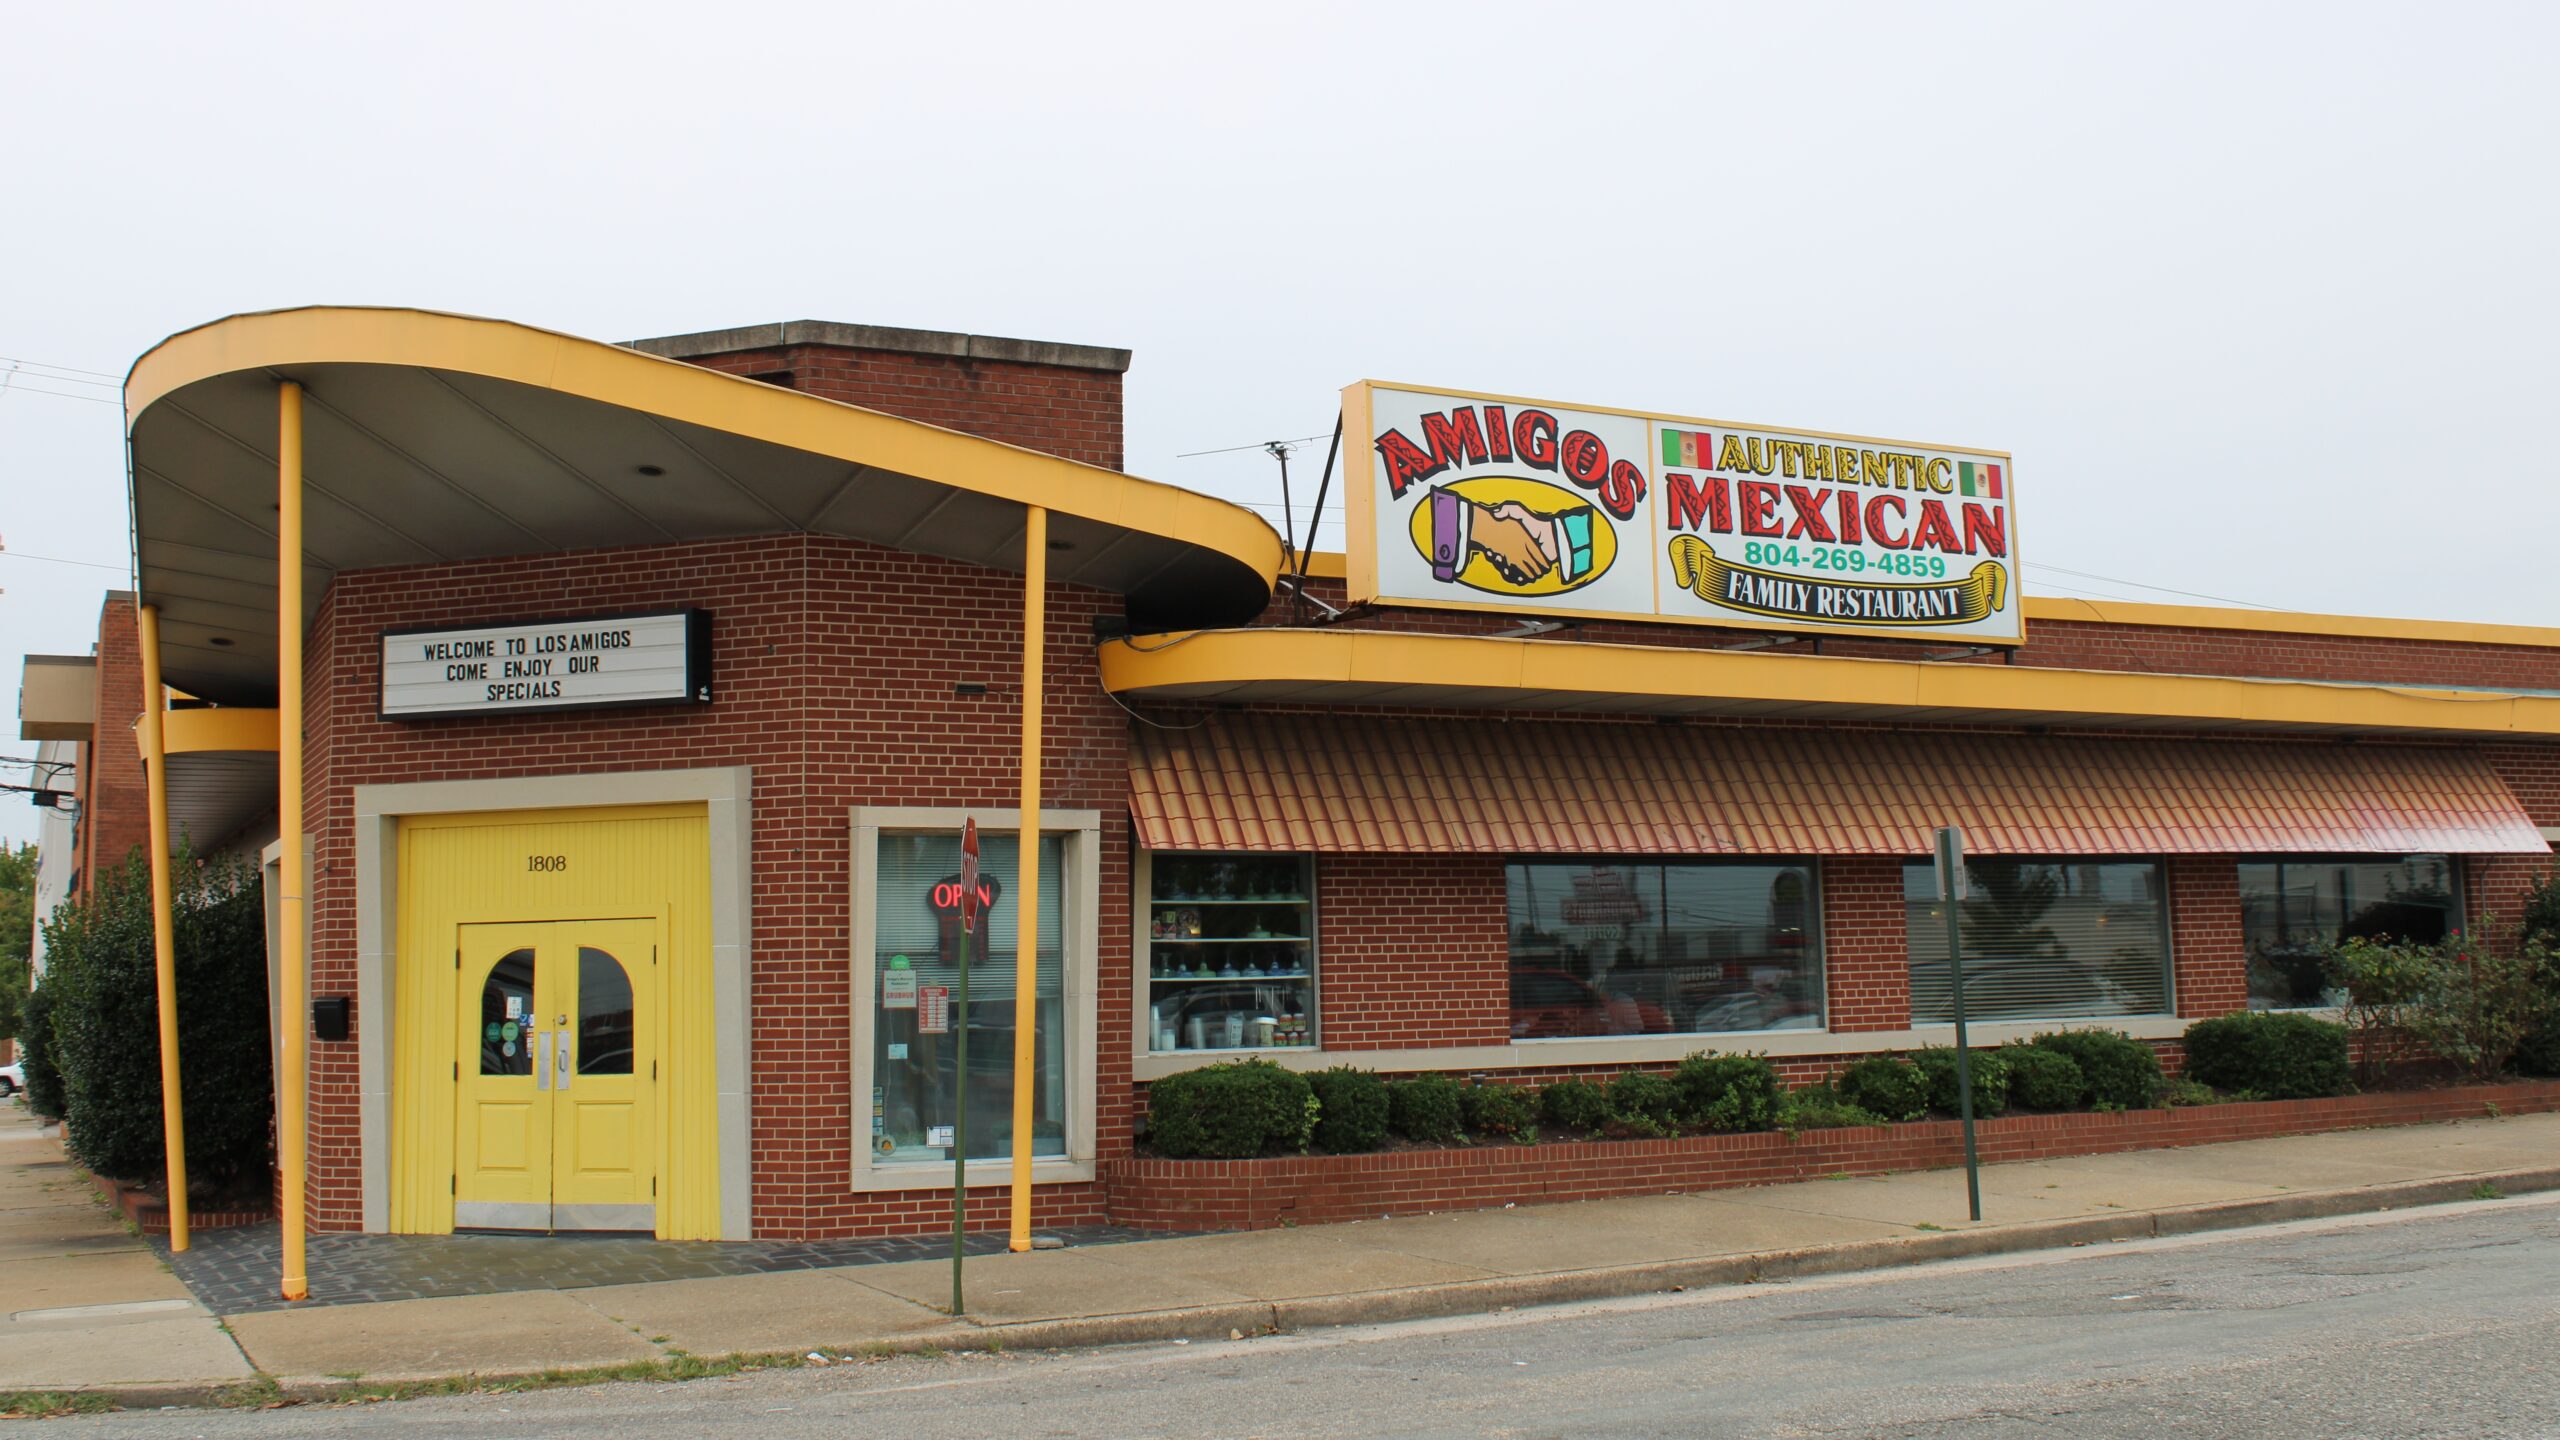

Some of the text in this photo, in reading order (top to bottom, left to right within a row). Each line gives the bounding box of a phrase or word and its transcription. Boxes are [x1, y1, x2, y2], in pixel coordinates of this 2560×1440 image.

[1374, 405, 1648, 521] AMIGOS
[1716, 434, 1953, 495] AUTHENTIC
[1665, 473, 2007, 558] MEXICAN
[1744, 541, 1946, 579] 804-269-4859
[1727, 570, 1960, 620] FAMILY RESTAURANT
[424, 640, 495, 661] WELCOME
[506, 638, 526, 656] TO
[447, 655, 600, 681] COME ENJOY OUR
[487, 680, 561, 701] SPECIALS
[527, 855, 567, 872] 1808
[962, 850, 978, 895] STOP
[934, 883, 991, 908] OPN
